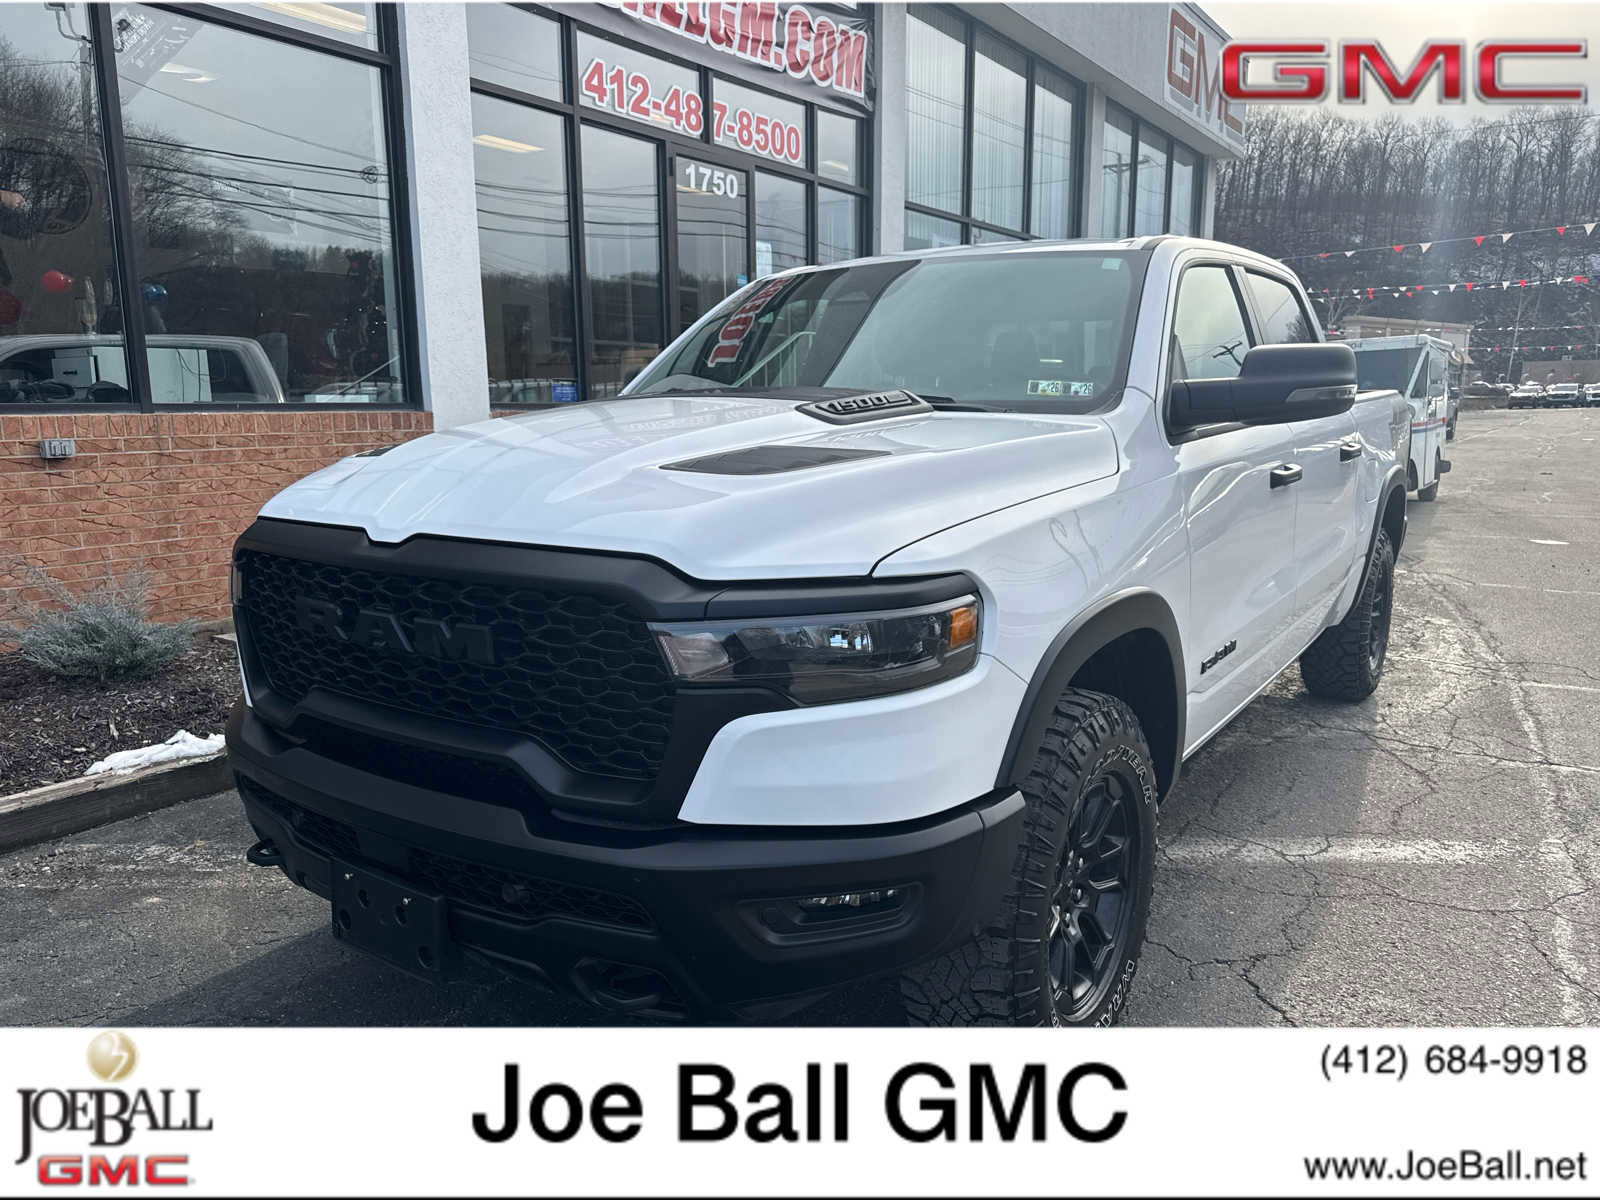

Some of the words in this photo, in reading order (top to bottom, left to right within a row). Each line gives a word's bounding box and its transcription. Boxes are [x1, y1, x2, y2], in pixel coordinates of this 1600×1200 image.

[685, 163, 738, 198] 1750
[827, 393, 890, 412] 1500
[296, 595, 495, 665] RAM
